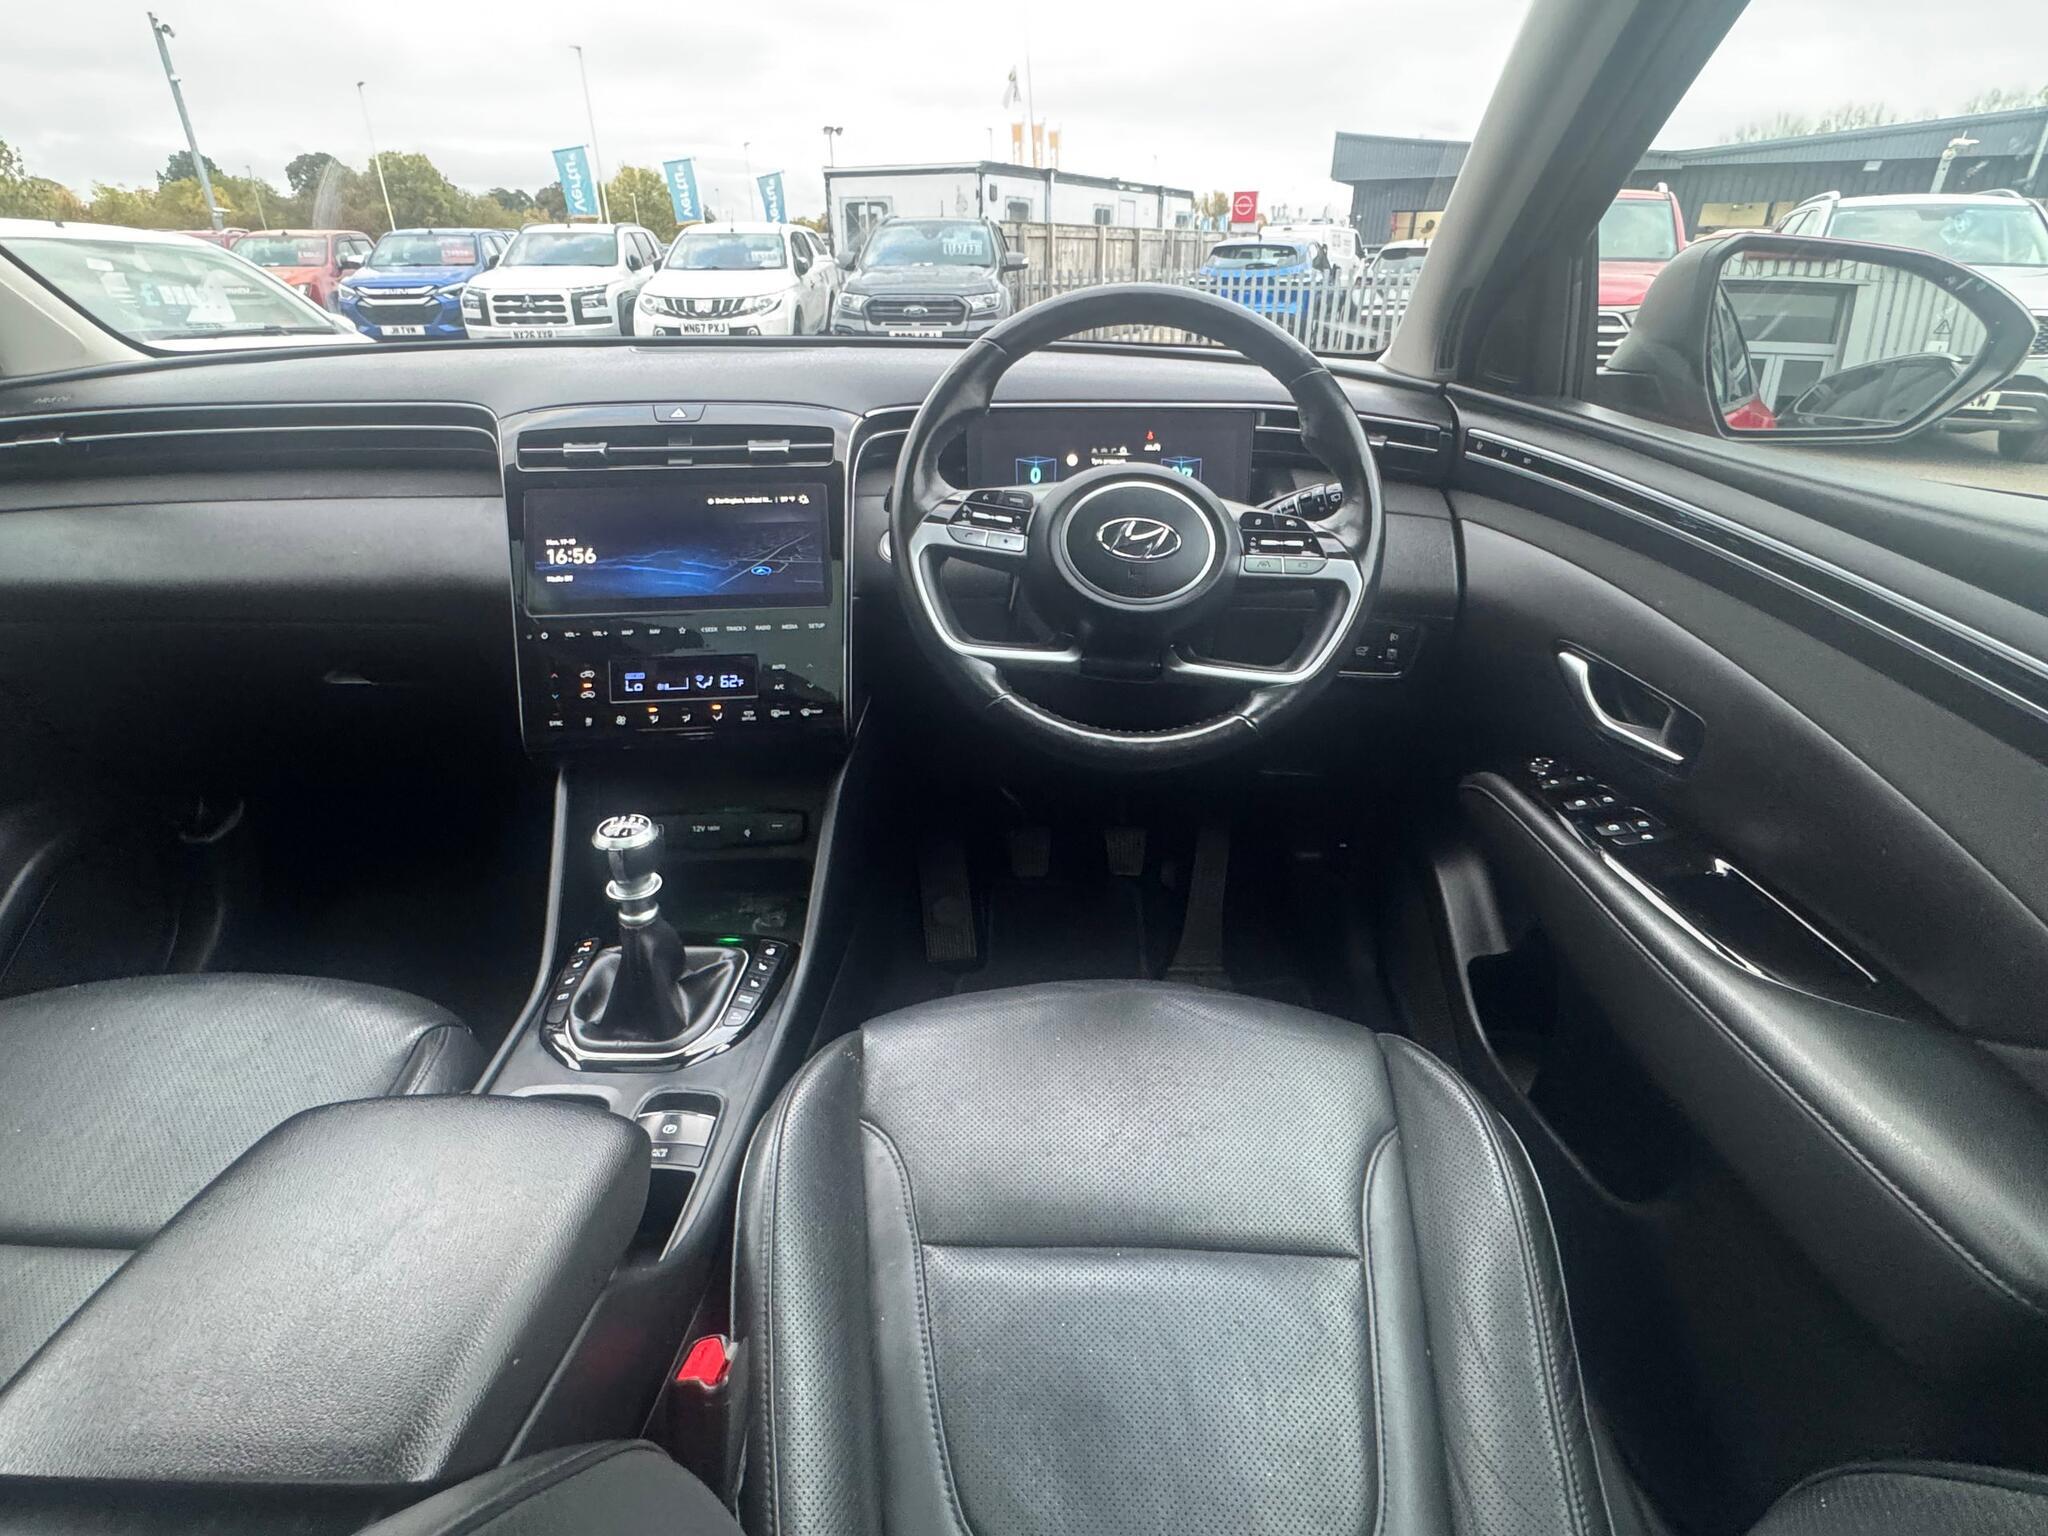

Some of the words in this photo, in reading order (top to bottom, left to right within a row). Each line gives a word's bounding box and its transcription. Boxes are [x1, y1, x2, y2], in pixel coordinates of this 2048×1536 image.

[1030, 467, 1042, 484] 0
[546, 547, 597, 565] 16:56
[692, 824, 706, 832] 12V
